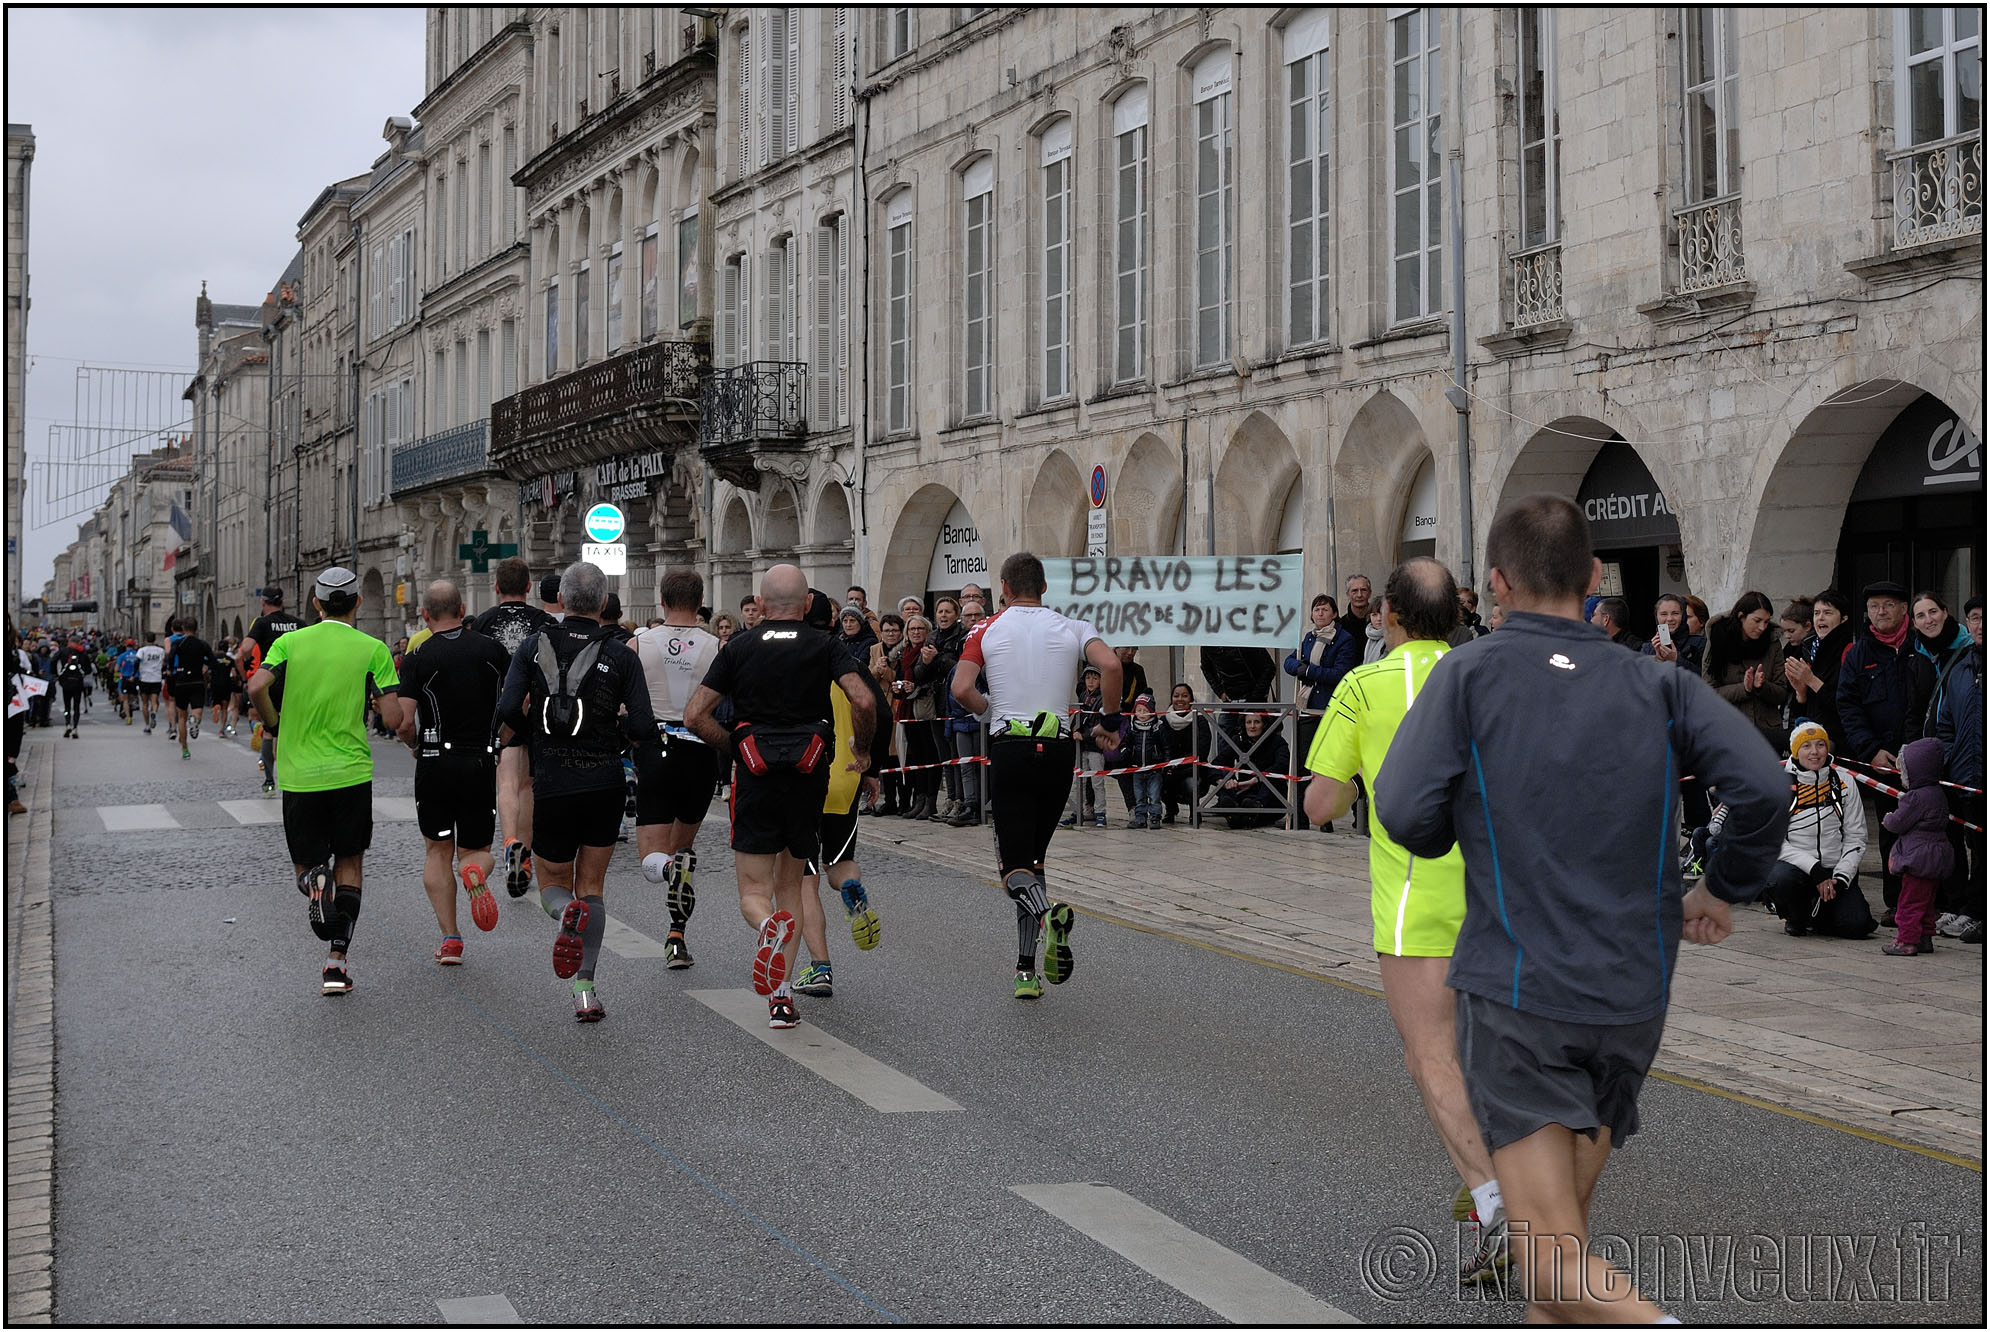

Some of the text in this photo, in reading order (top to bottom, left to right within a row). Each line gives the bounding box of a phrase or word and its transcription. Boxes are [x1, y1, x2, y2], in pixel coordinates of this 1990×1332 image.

[596, 451, 665, 487] CAFÉ de la PAIX
[611, 480, 649, 502] BRASSERIE
[1584, 492, 1649, 522] CRÉDIT
[943, 524, 981, 548] Banqu
[587, 547, 624, 556] TAXIS
[1070, 557, 1283, 596] BRAVO LES
[271, 622, 298, 632] PATRICE
[1154, 604, 1175, 625] DE
[1176, 602, 1297, 637] DUCEY
[663, 657, 692, 668] Triathlon
